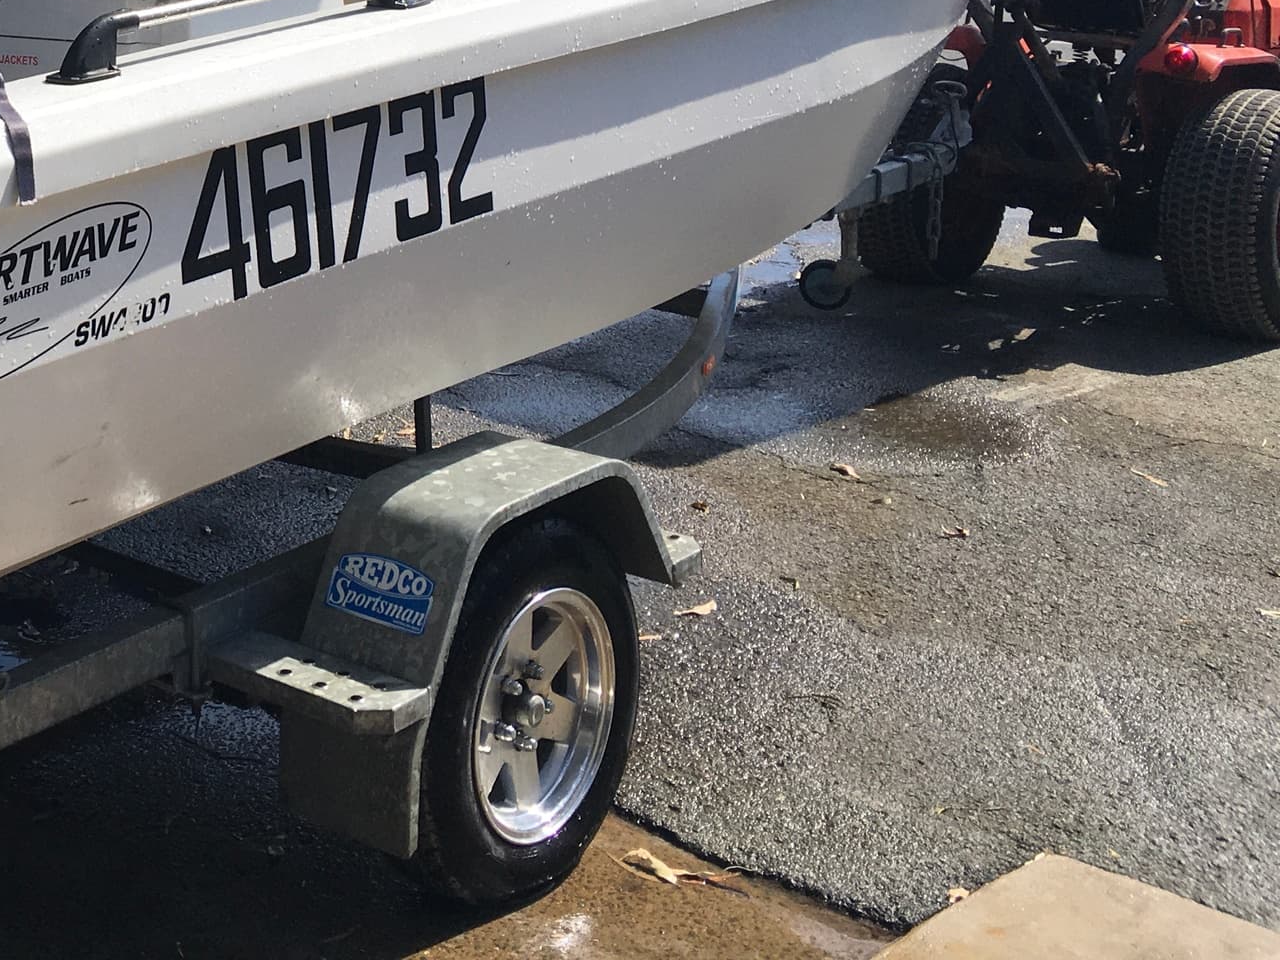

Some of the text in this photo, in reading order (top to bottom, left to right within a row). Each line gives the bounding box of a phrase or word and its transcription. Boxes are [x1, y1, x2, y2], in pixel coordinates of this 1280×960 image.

[181, 76, 494, 301] 461732
[2, 281, 49, 307] SMARTER
[60, 267, 91, 286] BOATS
[345, 557, 428, 596] REDCO
[329, 577, 426, 626] Sportsman
